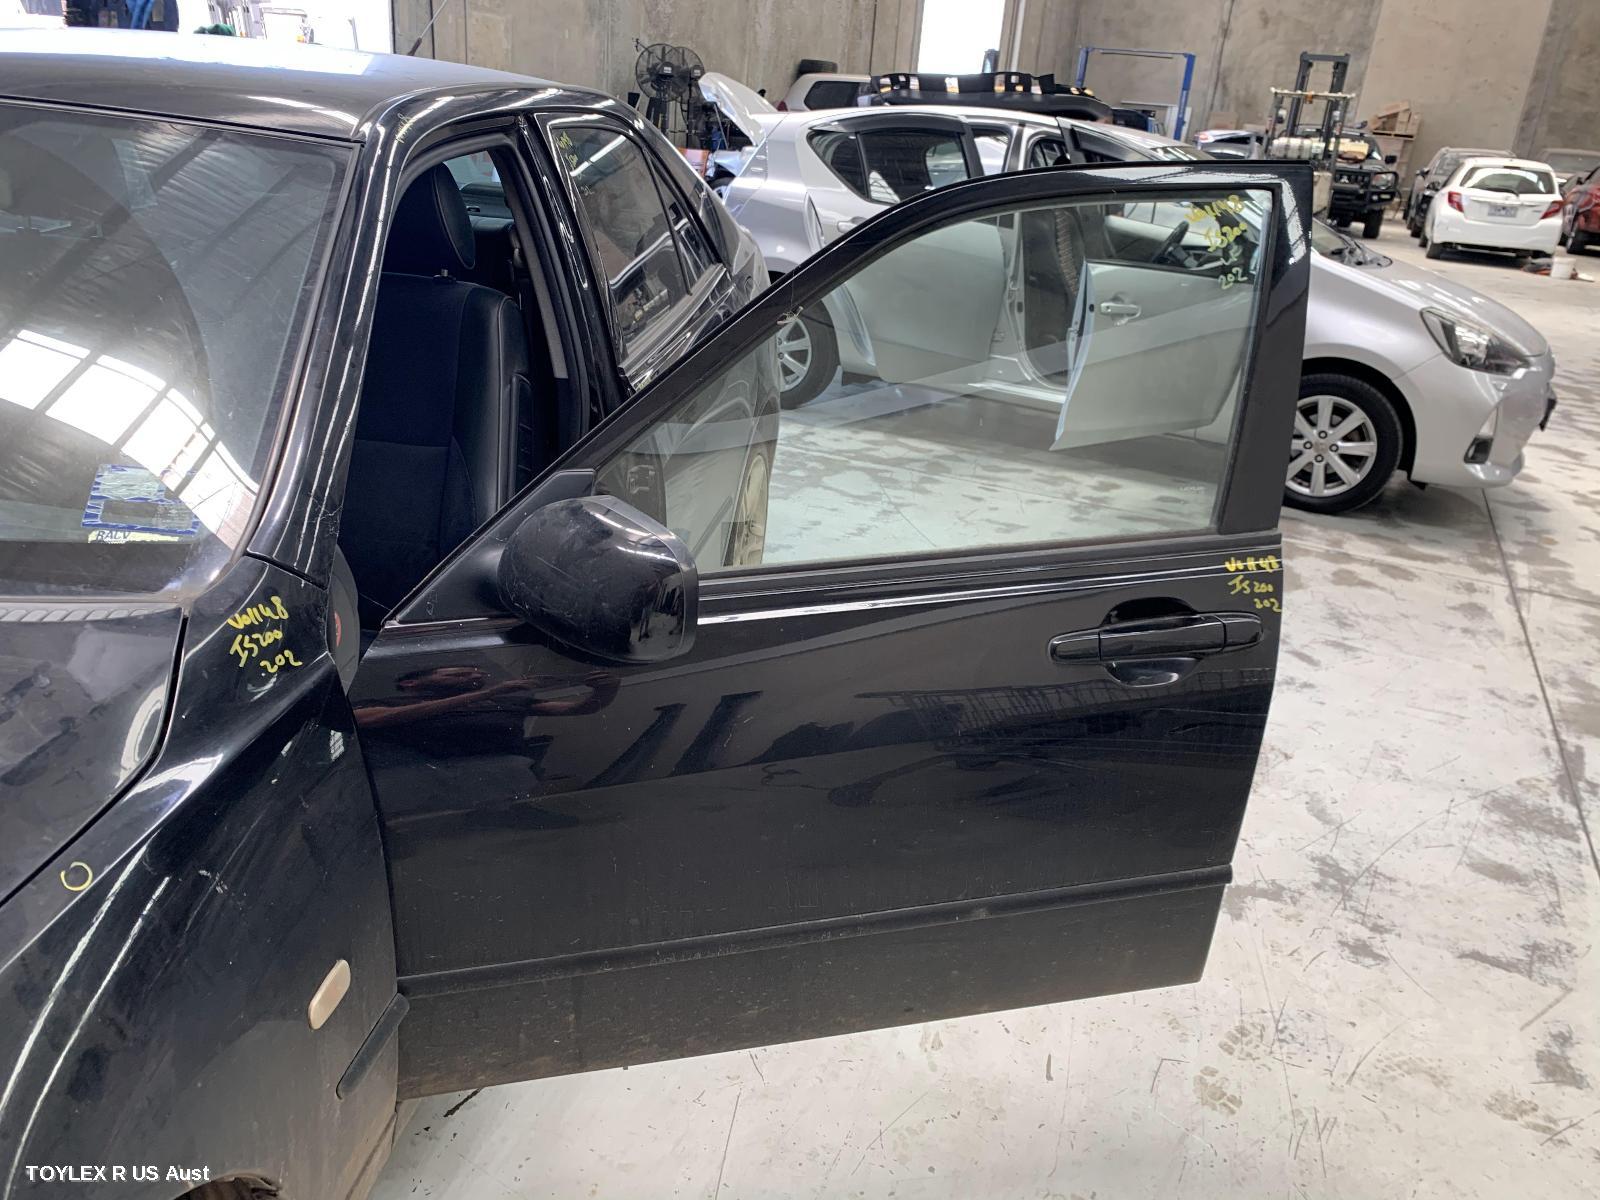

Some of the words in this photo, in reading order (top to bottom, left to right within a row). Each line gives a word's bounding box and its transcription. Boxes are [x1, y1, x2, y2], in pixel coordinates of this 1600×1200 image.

[1218, 267, 1248, 290] 202
[1253, 598, 1282, 613] 202
[259, 649, 303, 673] 202
